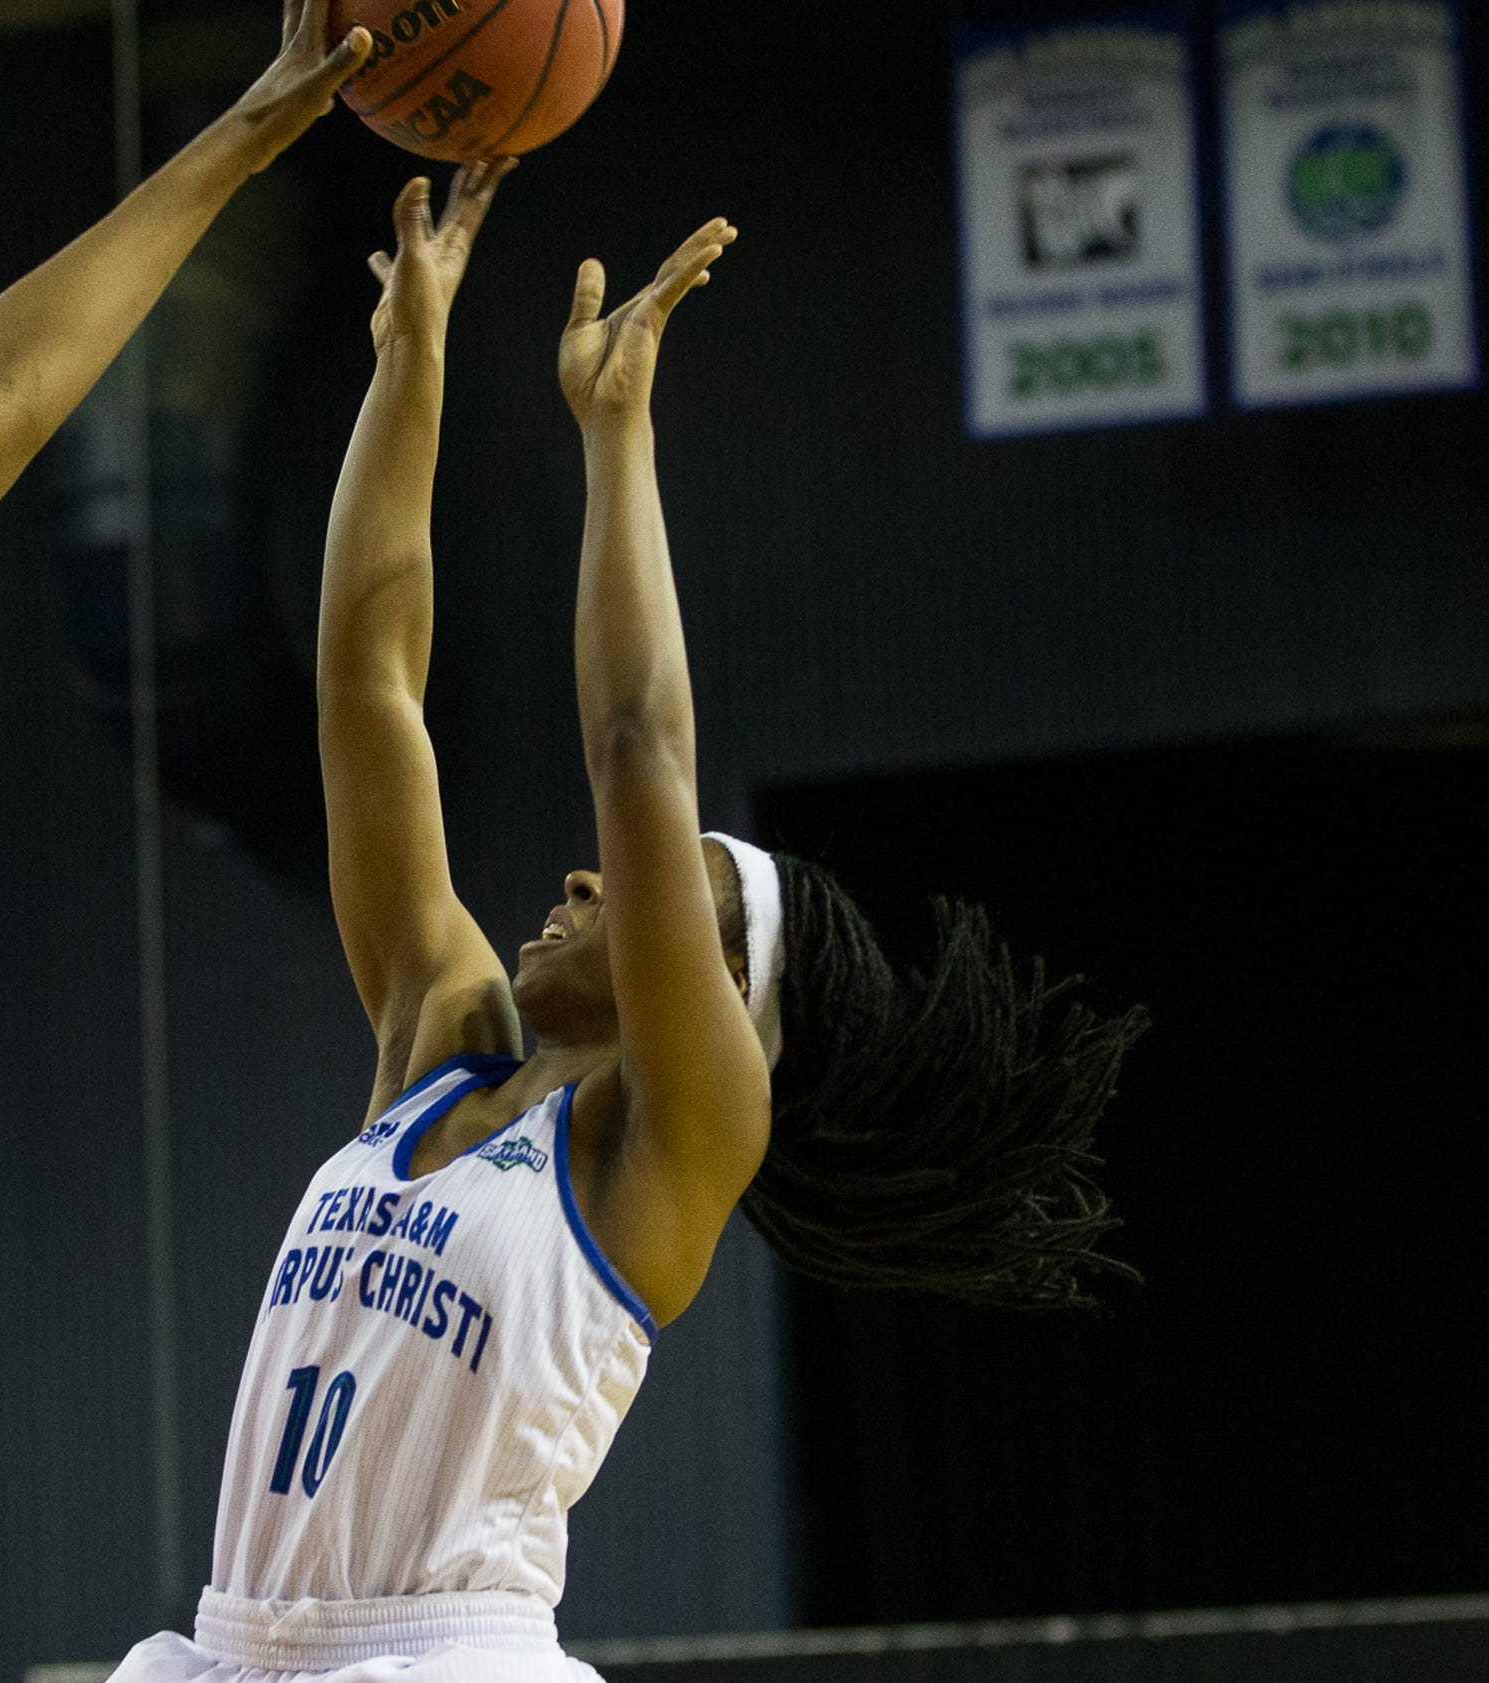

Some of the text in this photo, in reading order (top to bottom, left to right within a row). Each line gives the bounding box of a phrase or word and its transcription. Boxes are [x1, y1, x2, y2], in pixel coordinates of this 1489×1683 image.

[357, 0, 463, 78] son
[1008, 329, 1166, 400] 2005
[1278, 304, 1434, 374] 2010
[307, 1186, 460, 1257] TEXAS A&M
[359, 1249, 494, 1375] CHRISTI
[268, 1365, 357, 1500] 10
